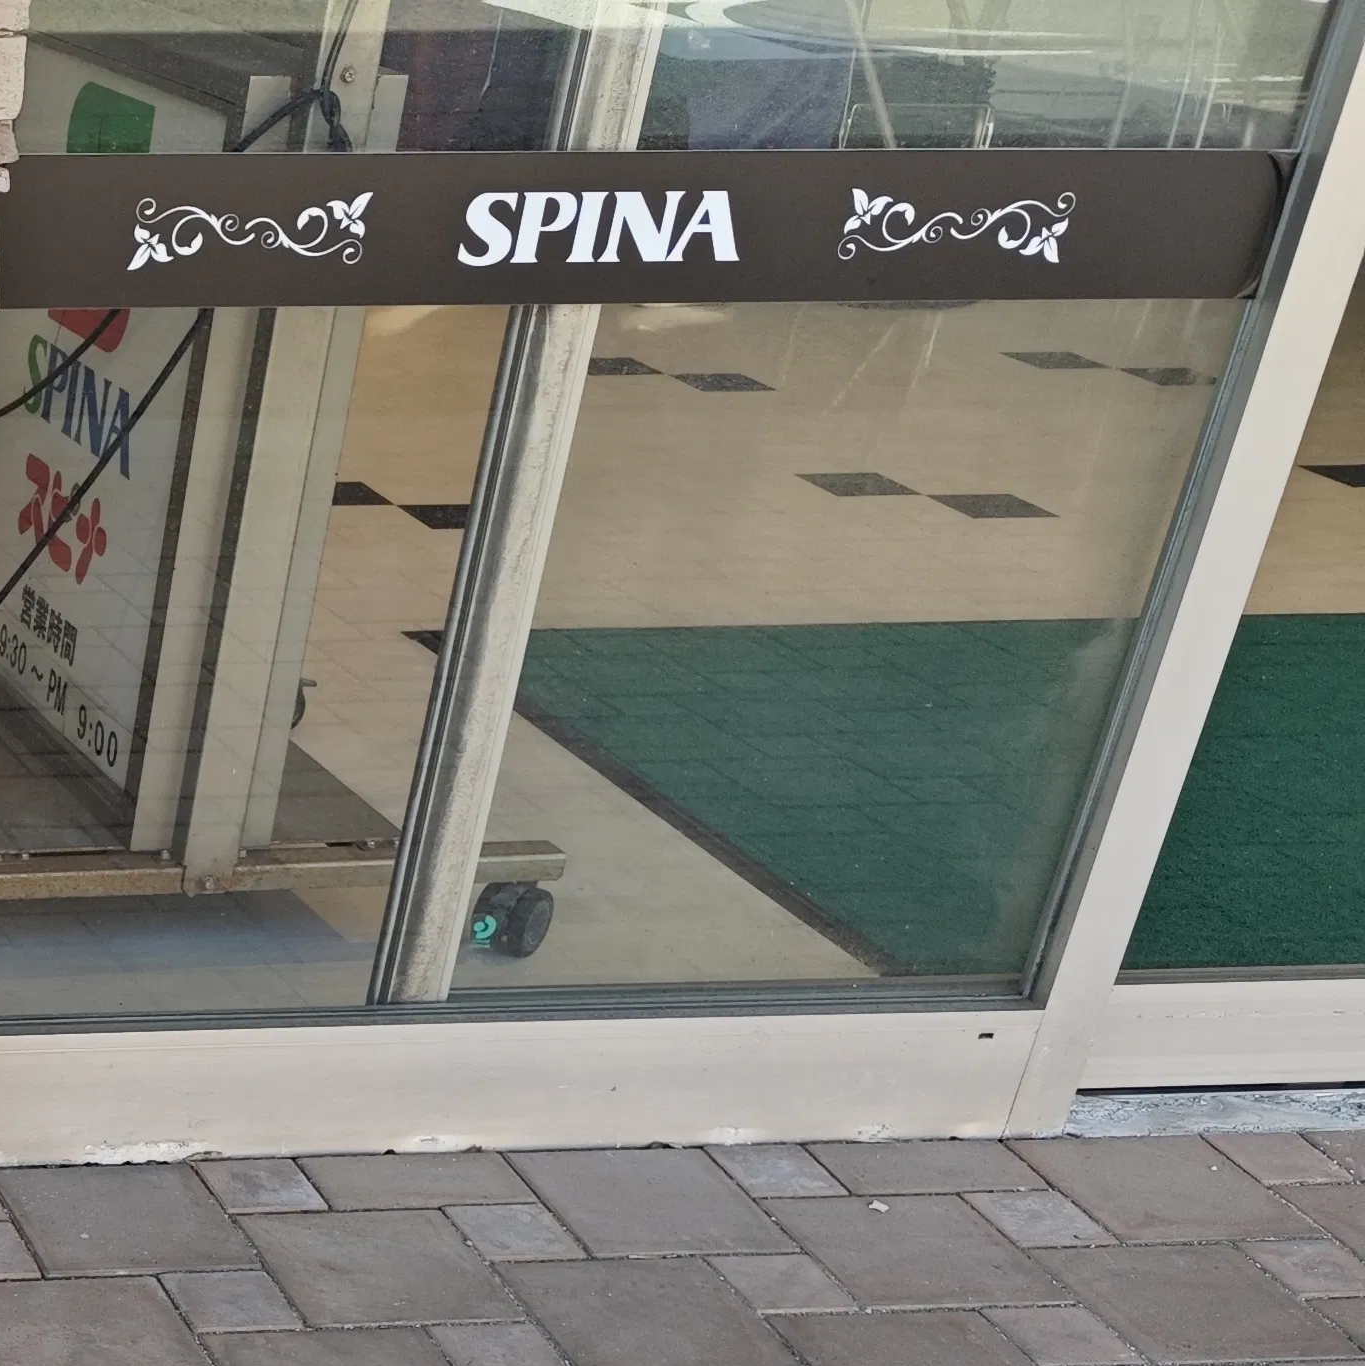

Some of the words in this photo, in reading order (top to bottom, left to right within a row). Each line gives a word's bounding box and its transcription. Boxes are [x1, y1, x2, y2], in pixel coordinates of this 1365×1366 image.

[457, 190, 740, 267] SPINA
[22, 333, 131, 481] SPINA
[20, 584, 78, 667] 営業時間
[46, 668, 68, 716] PM
[76, 704, 118, 768] 9:00
